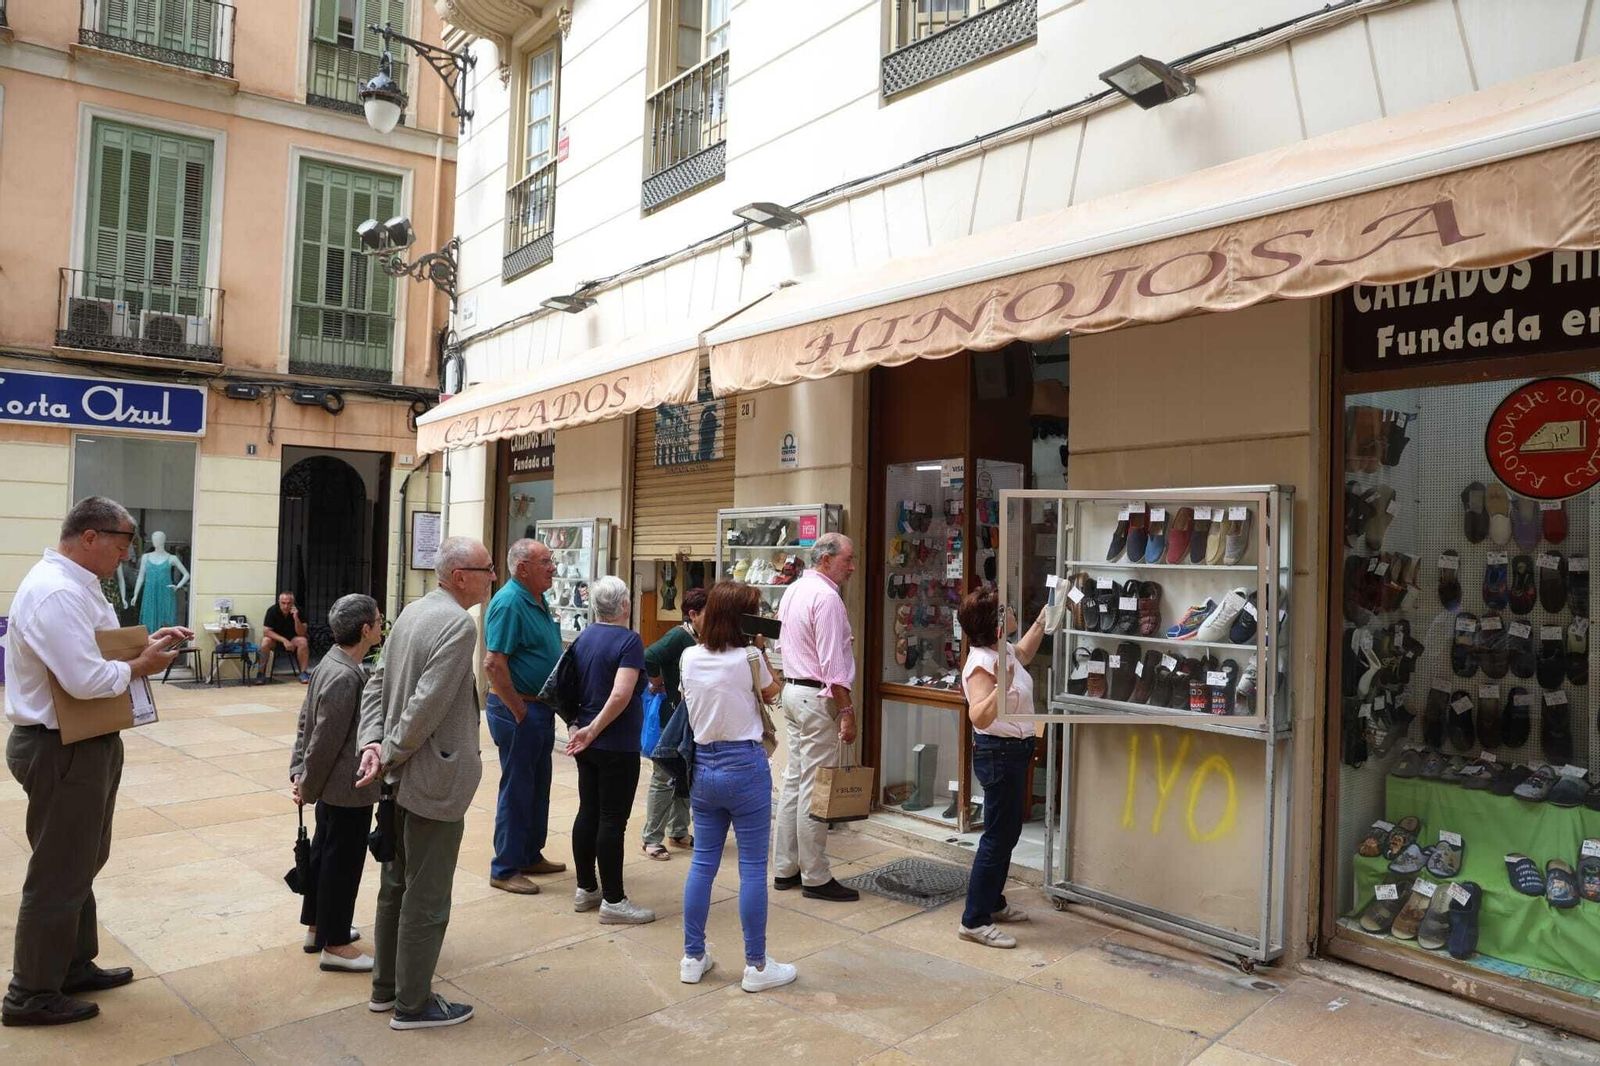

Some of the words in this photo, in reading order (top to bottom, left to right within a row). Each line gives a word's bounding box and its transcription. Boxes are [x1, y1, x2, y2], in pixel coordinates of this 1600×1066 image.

[795, 199, 1486, 366] HINOJOSA
[1377, 308, 1541, 358] Fundada
[0, 376, 70, 419] osta
[444, 376, 630, 444] CALZADOS
[741, 403, 750, 416] 20
[513, 454, 540, 471] Fundada
[541, 456, 550, 467] en
[951, 465, 964, 473] VISA
